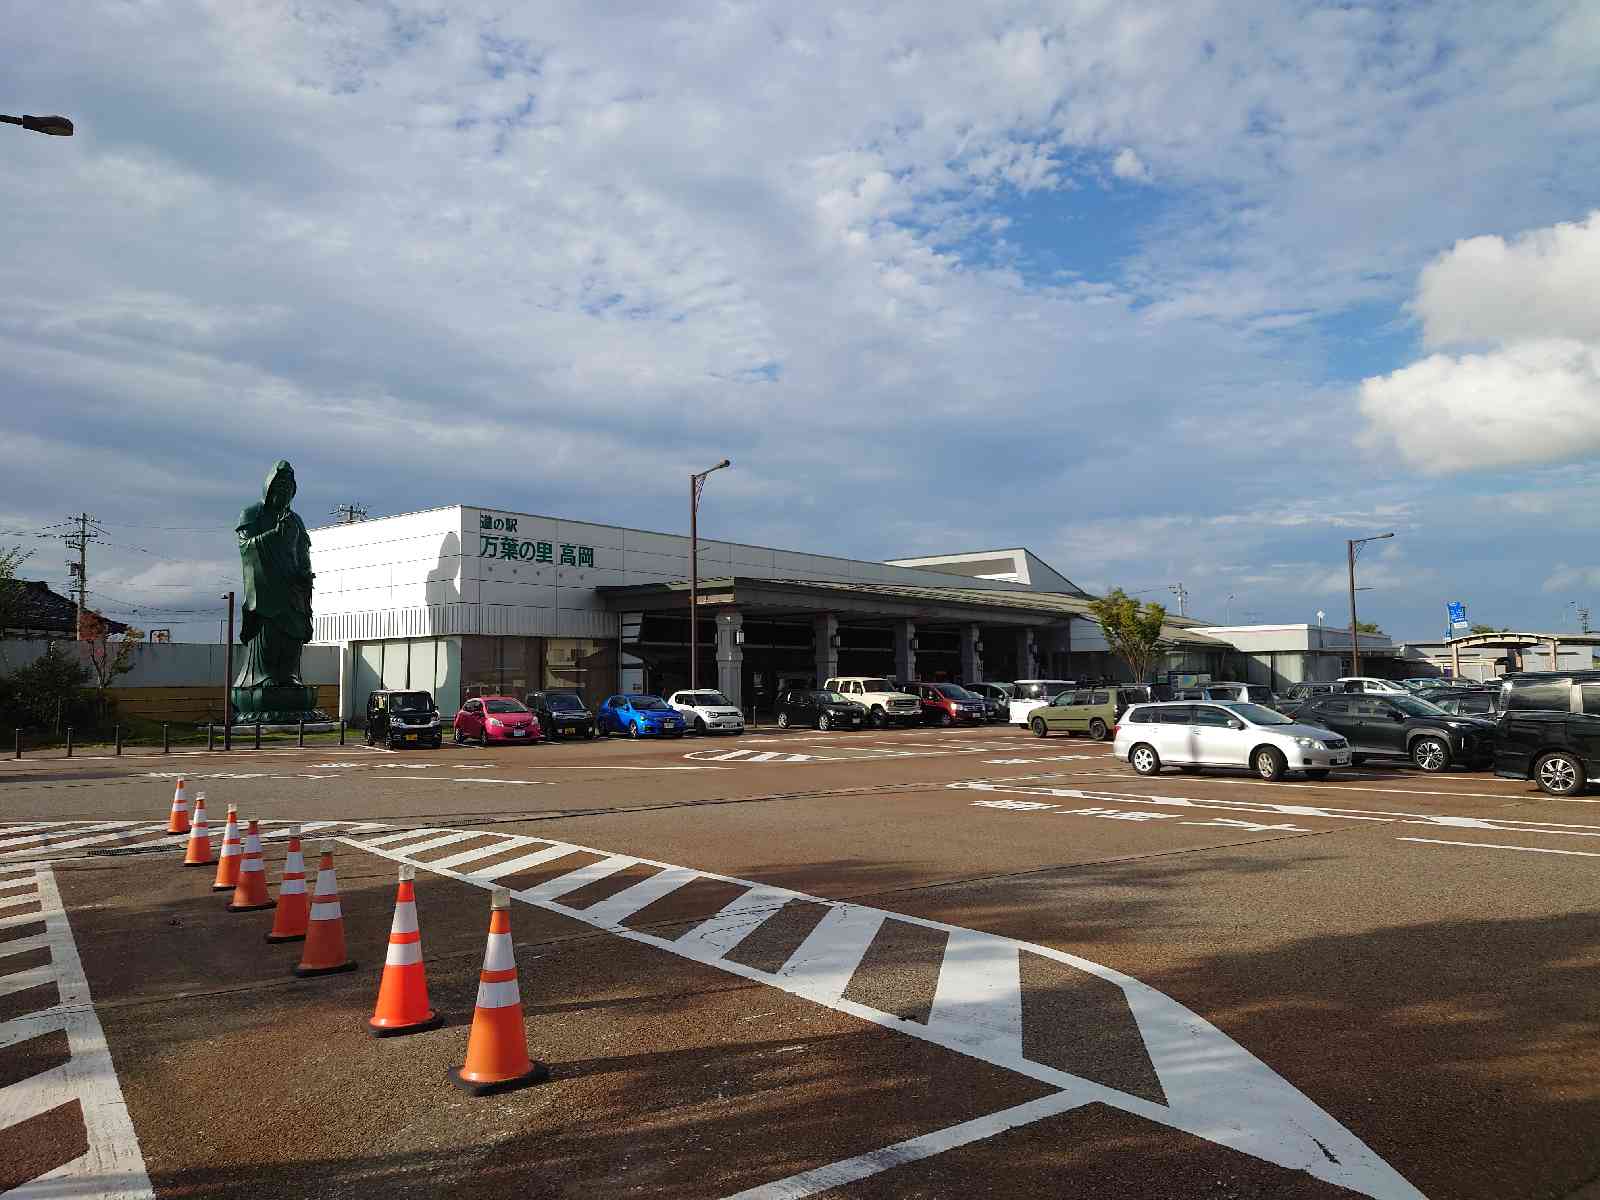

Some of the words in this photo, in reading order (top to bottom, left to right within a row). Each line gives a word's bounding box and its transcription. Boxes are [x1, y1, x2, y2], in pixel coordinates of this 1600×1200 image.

[479, 514, 518, 532] 道の駅
[480, 535, 553, 564] 万葉の里
[560, 543, 594, 568] 高岡
